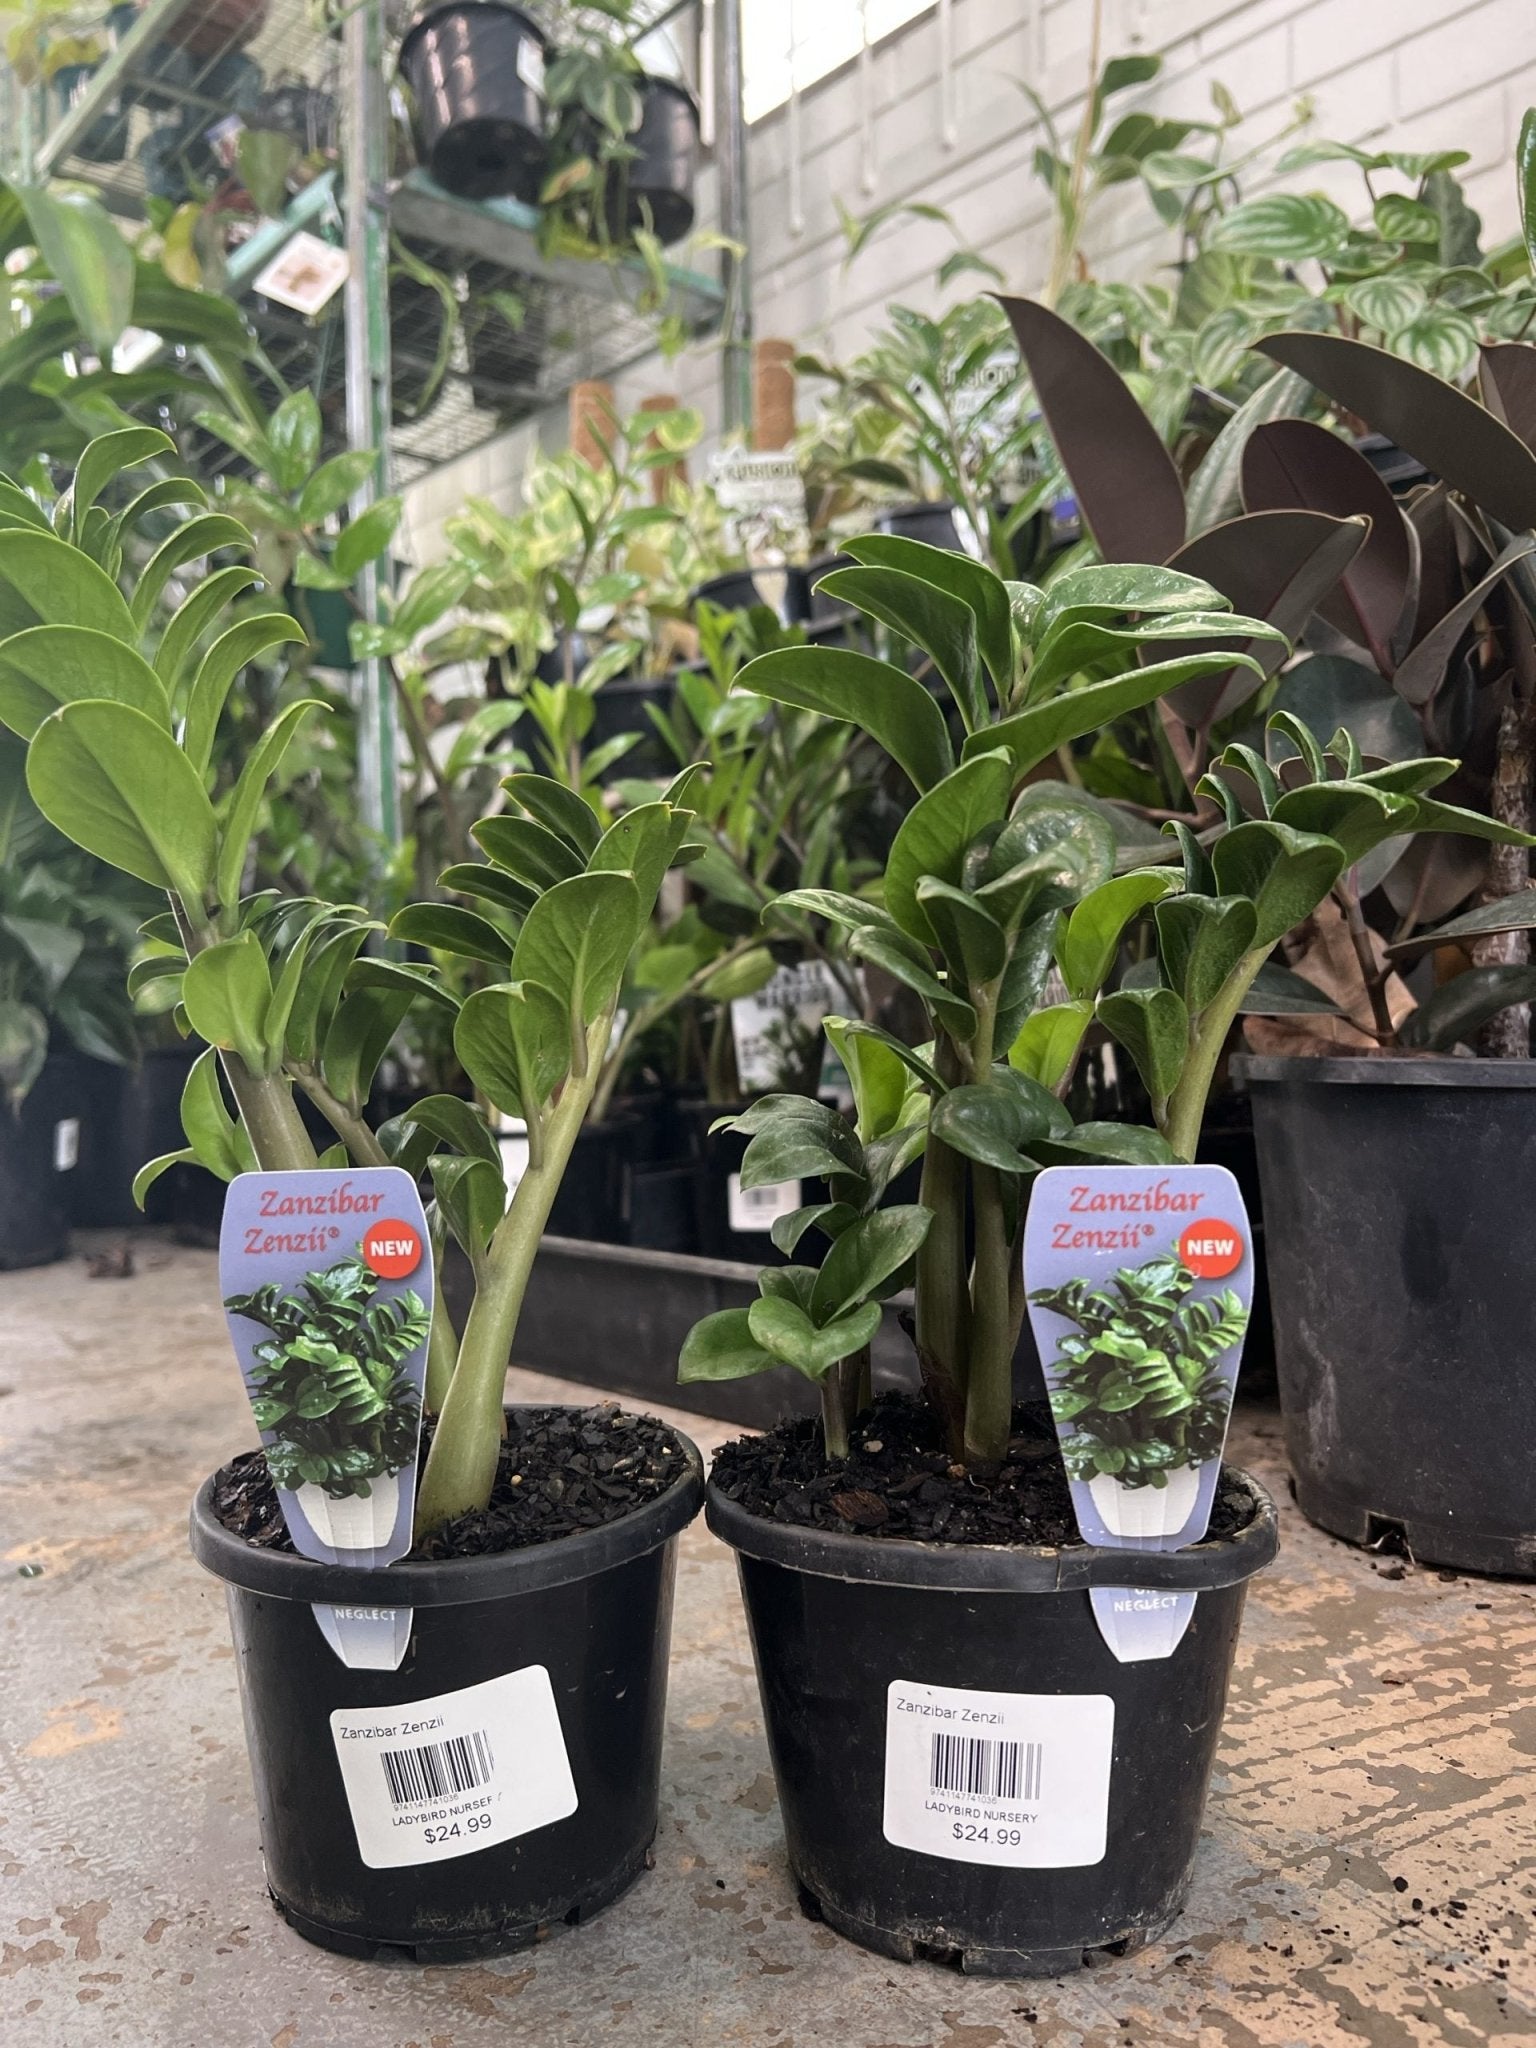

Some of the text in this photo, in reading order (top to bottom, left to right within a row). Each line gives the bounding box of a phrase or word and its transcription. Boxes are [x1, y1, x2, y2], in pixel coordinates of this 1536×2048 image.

[259, 1181, 385, 1217] Zanzibar
[1069, 1179, 1205, 1212] Zanzibar
[370, 1240, 413, 1257] NEW
[1187, 1239, 1234, 1256] NEW
[335, 1609, 397, 1621] NEGLECT
[1114, 1597, 1179, 1612] NEGLECT
[897, 1697, 1005, 1724] Zanzibar Zenzii
[340, 1715, 445, 1739] Zanzibar Zenzii
[393, 1793, 459, 1812] 9741147741036
[930, 1787, 998, 1805] 9741147741036
[392, 1809, 447, 1826] LADYBIRD
[925, 1800, 1039, 1824] LADYBIRD NURSERY
[424, 1813, 492, 1844] $24.99
[952, 1823, 1022, 1846] $24.99
